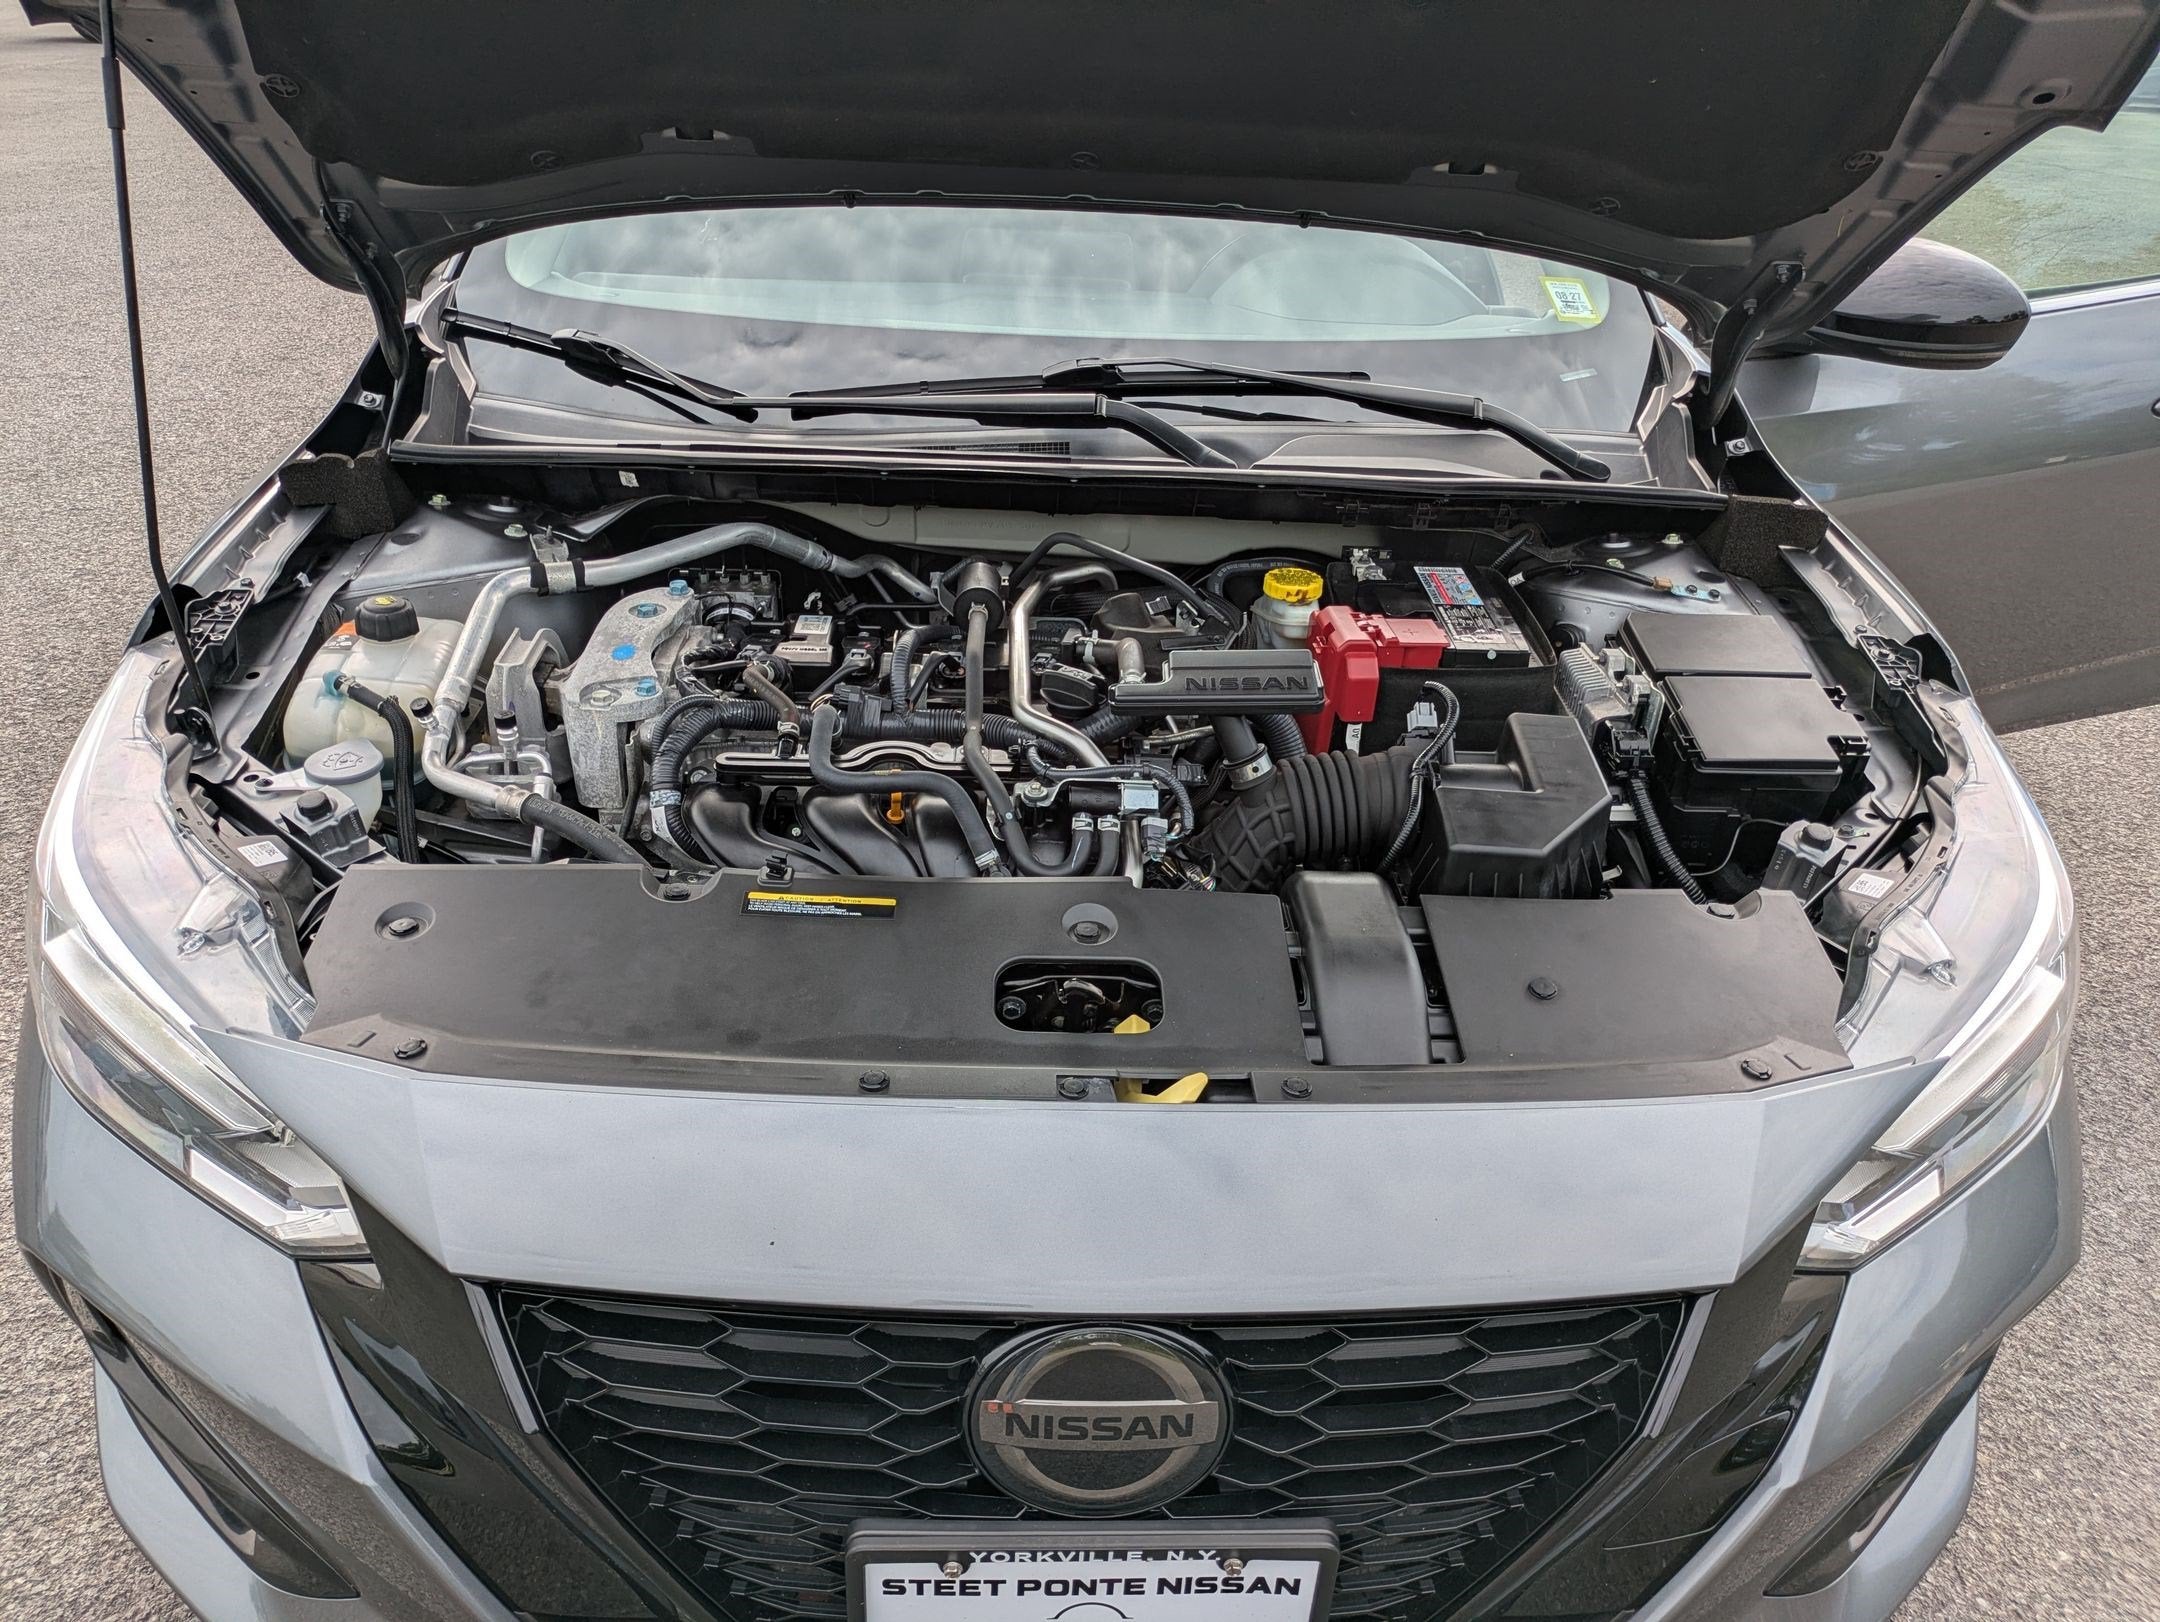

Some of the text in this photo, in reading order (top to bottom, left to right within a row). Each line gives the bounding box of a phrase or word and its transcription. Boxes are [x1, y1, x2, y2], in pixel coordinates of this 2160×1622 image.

[1185, 676, 1308, 691] NISSAN
[1005, 1412, 1194, 1442] NISSAN
[1166, 1549, 1221, 1561] N.Y.
[882, 1576, 1302, 1597] STEET PONTE NISSAN
